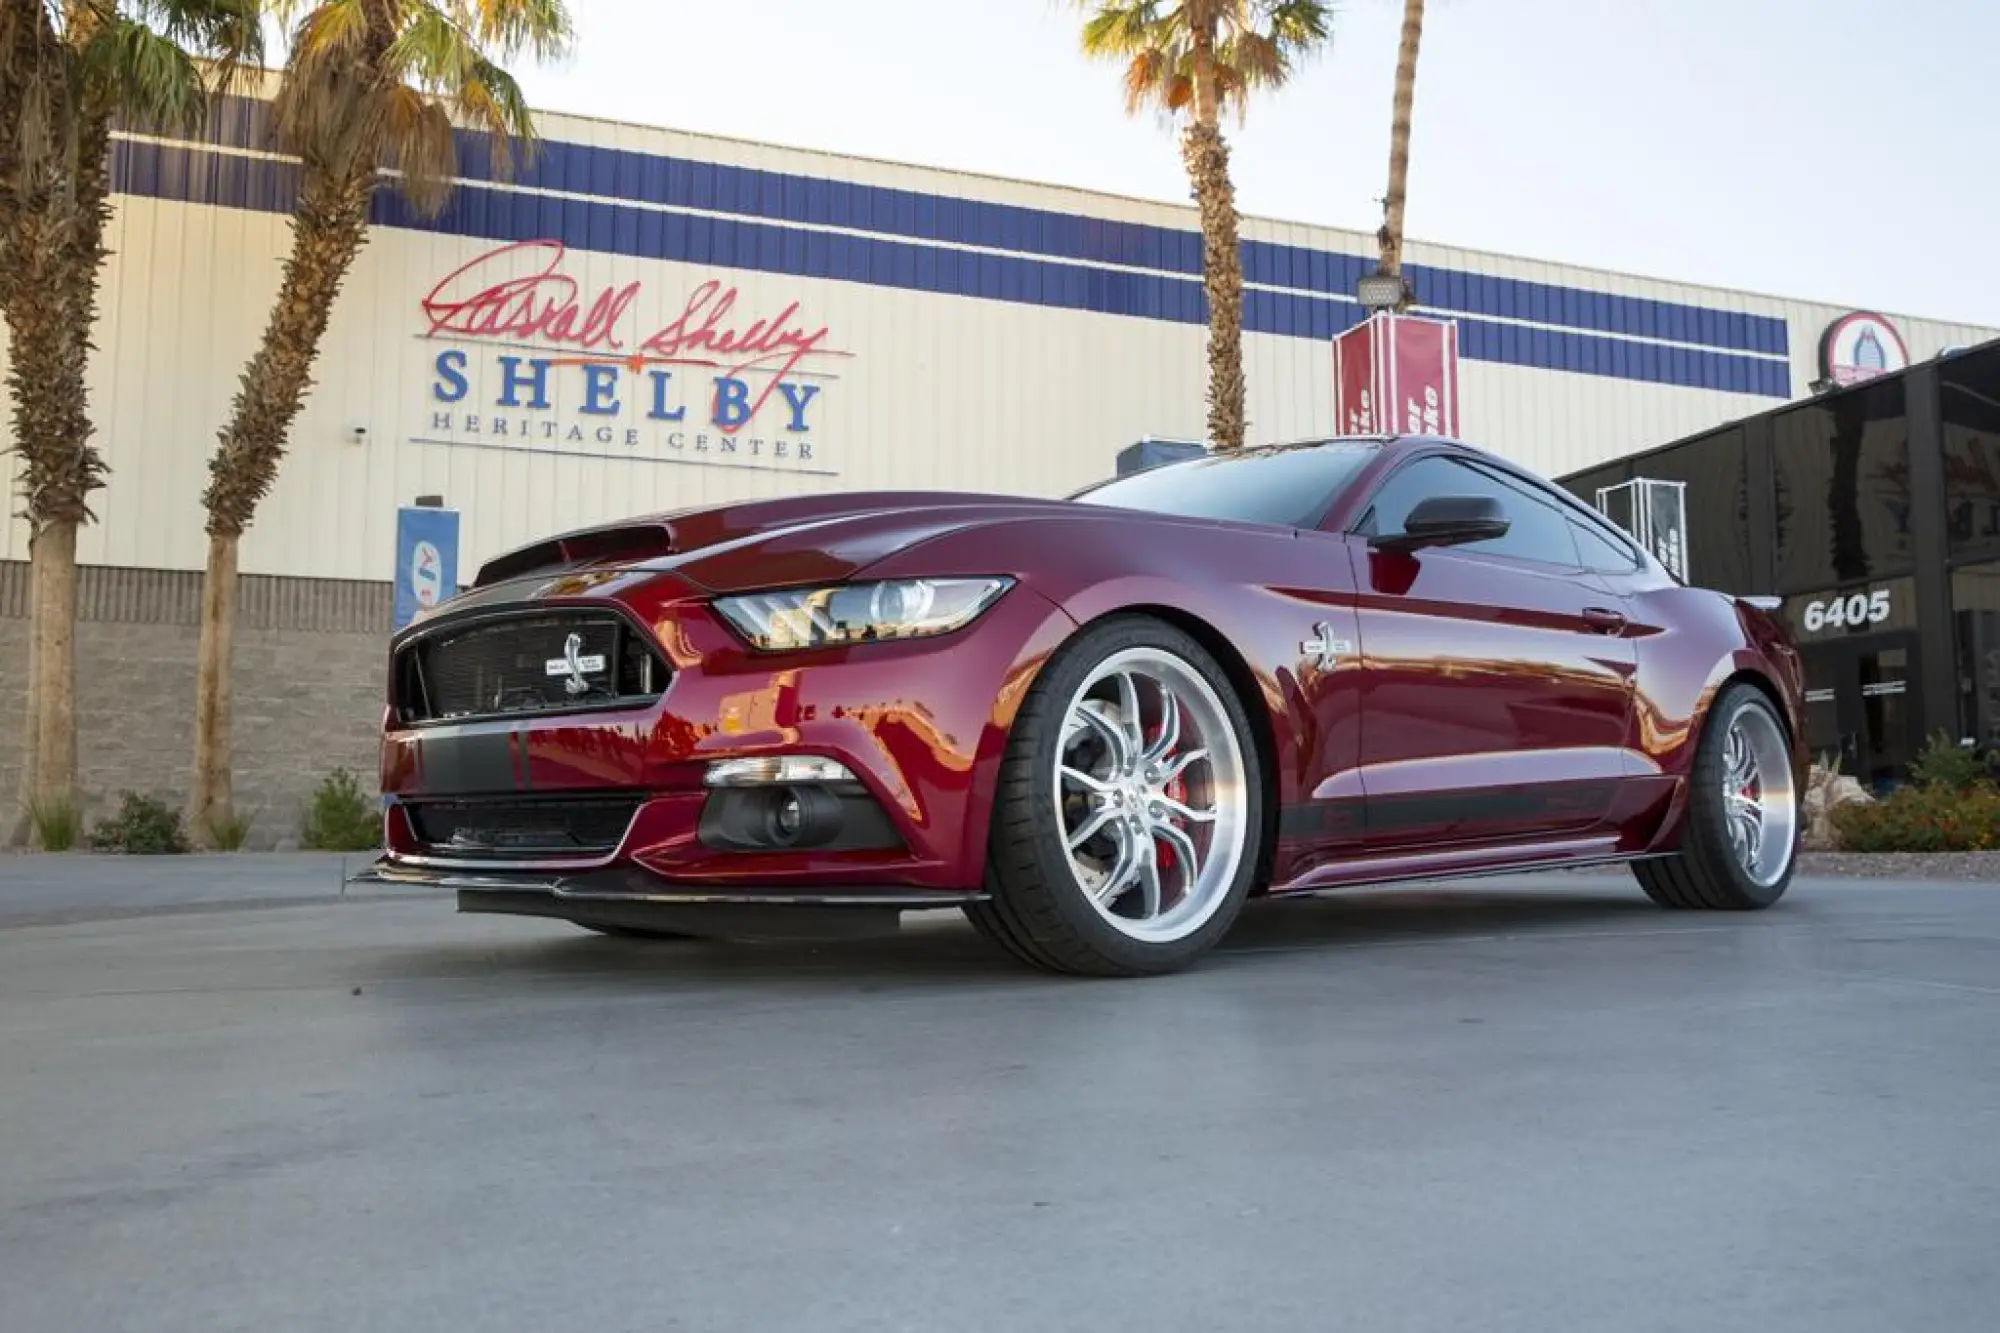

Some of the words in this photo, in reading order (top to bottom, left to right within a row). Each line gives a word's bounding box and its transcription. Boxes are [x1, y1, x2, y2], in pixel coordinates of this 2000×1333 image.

[641, 279, 857, 434] Shelby
[434, 350, 820, 432] SHELBY
[433, 412, 639, 446] HERITAGE
[667, 432, 812, 459] CENTER
[1805, 590, 1890, 632] 6405
